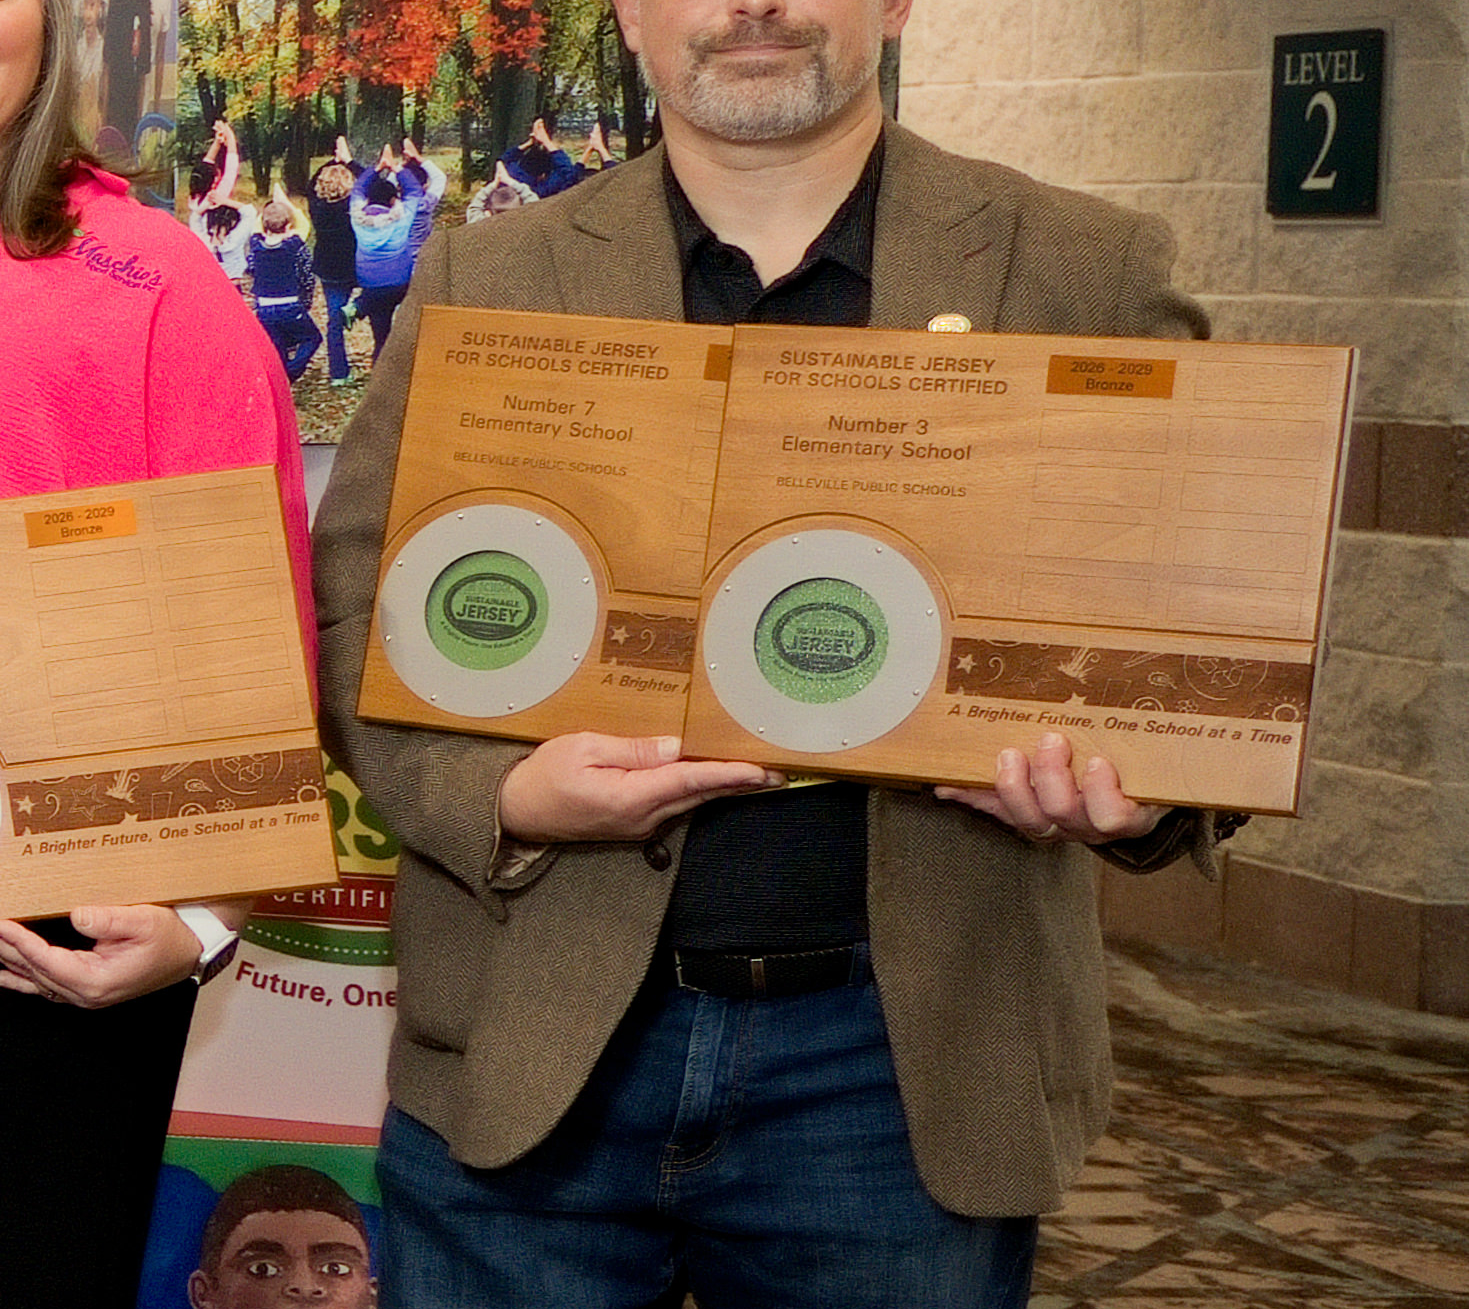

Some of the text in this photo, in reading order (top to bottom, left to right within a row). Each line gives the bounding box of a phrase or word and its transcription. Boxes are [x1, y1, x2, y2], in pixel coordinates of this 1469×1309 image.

[1284, 50, 1365, 85] LEVEL
[1299, 90, 1338, 190] 2
[460, 332, 658, 359] SUSTAINABLE JERSEY
[444, 350, 669, 380] FOR SCHOOLS CERTIFIED
[779, 352, 996, 372] SUSTAINABLE JERSEY
[762, 372, 1008, 393] FOR SCHOOLS CERTIFIED
[502, 395, 595, 417] Number 7
[458, 413, 632, 442] Elementary School
[827, 415, 929, 435] Number 3
[781, 436, 971, 460] Elementary School
[43, 511, 73, 524] 2026
[84, 506, 115, 519] 2029
[60, 525, 103, 538] Bronze
[235, 960, 333, 1007] Future,
